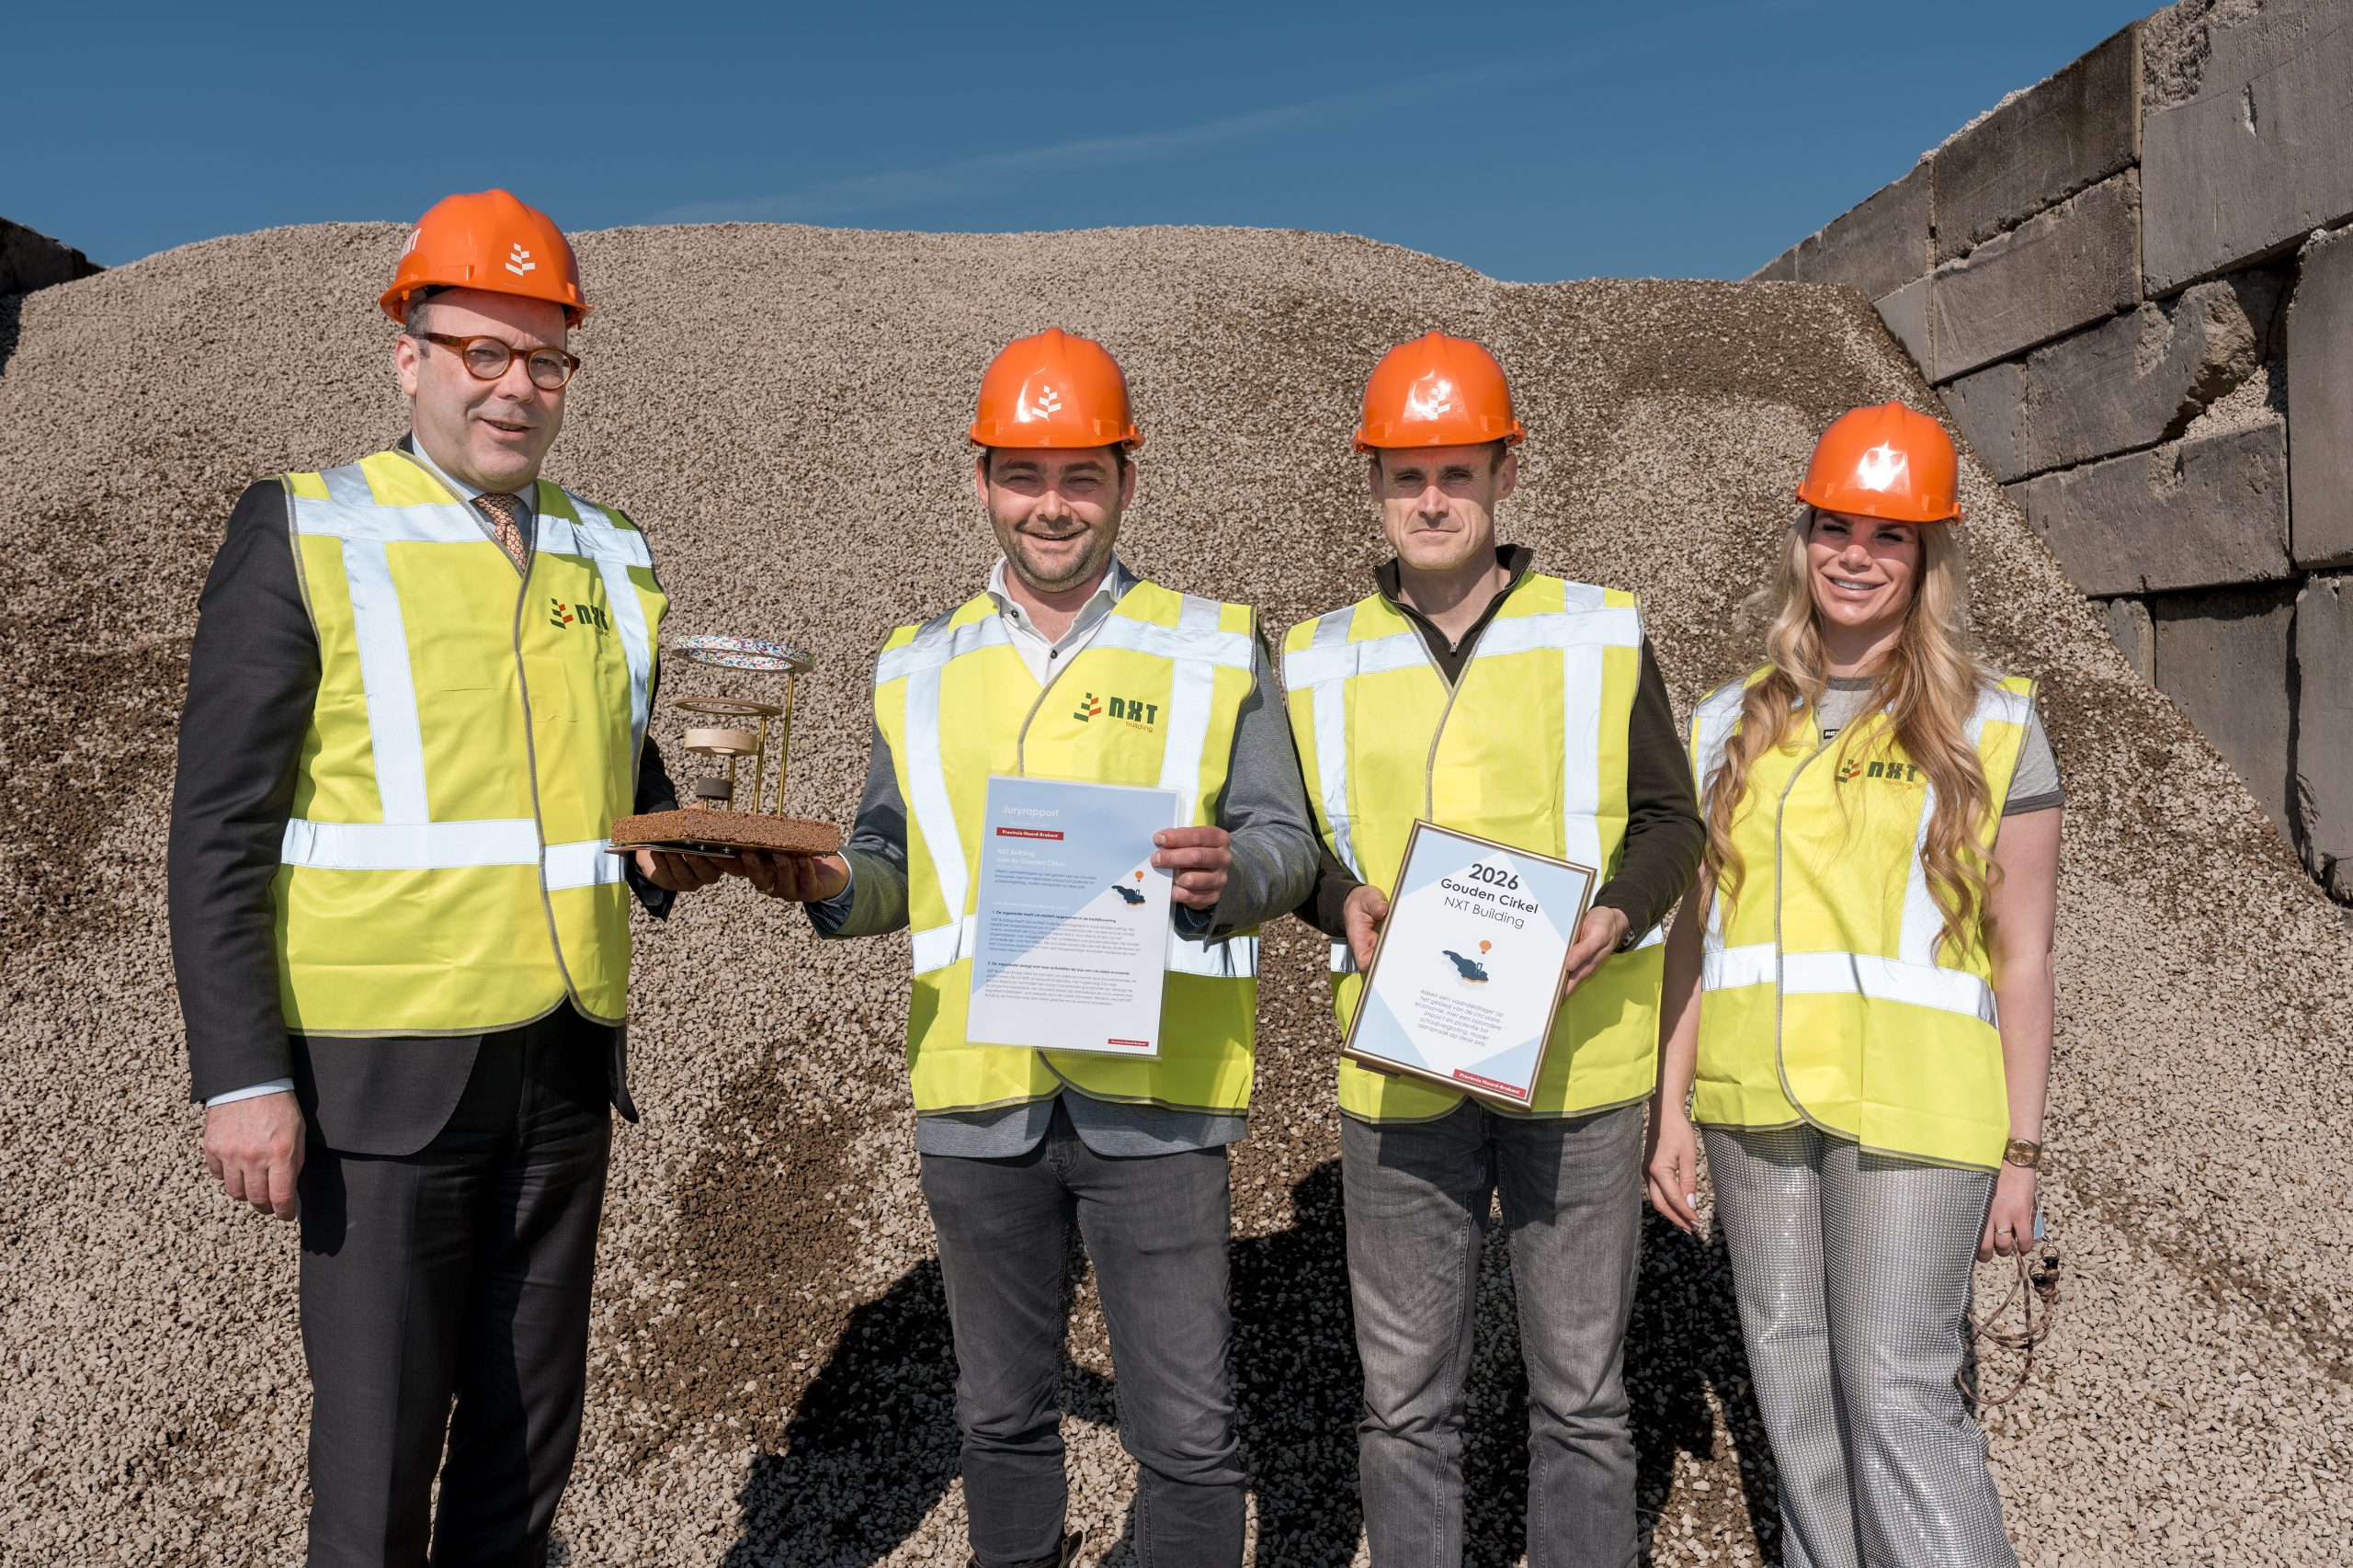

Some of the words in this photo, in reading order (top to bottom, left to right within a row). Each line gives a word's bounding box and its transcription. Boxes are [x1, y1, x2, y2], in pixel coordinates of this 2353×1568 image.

[1125, 722, 1153, 733] building
[1002, 805, 1059, 817] Juryrapport
[1010, 849, 1035, 857] Building
[1468, 863, 1519, 890] 2026
[1441, 878, 1495, 902] Gouden
[1499, 894, 1538, 914] Cirkel
[1444, 896, 1470, 911] NXT
[1472, 904, 1525, 929] Building
[1420, 989, 1438, 998] Alleen
[1450, 998, 1495, 1014] vaandeldrager
[1430, 999, 1452, 1009] gebied
[1473, 1012, 1500, 1023] circulaire
[1418, 1023, 1449, 1036] aanspraak
[1423, 1011, 1445, 1020] impact
[1454, 1020, 1479, 1031] potentie
[1471, 1018, 1502, 1031] bijzondere
[1470, 1032, 1489, 1040] maakt
[1459, 1072, 1481, 1083] Provincie
[1482, 1079, 1519, 1094] Noord-Brabant
